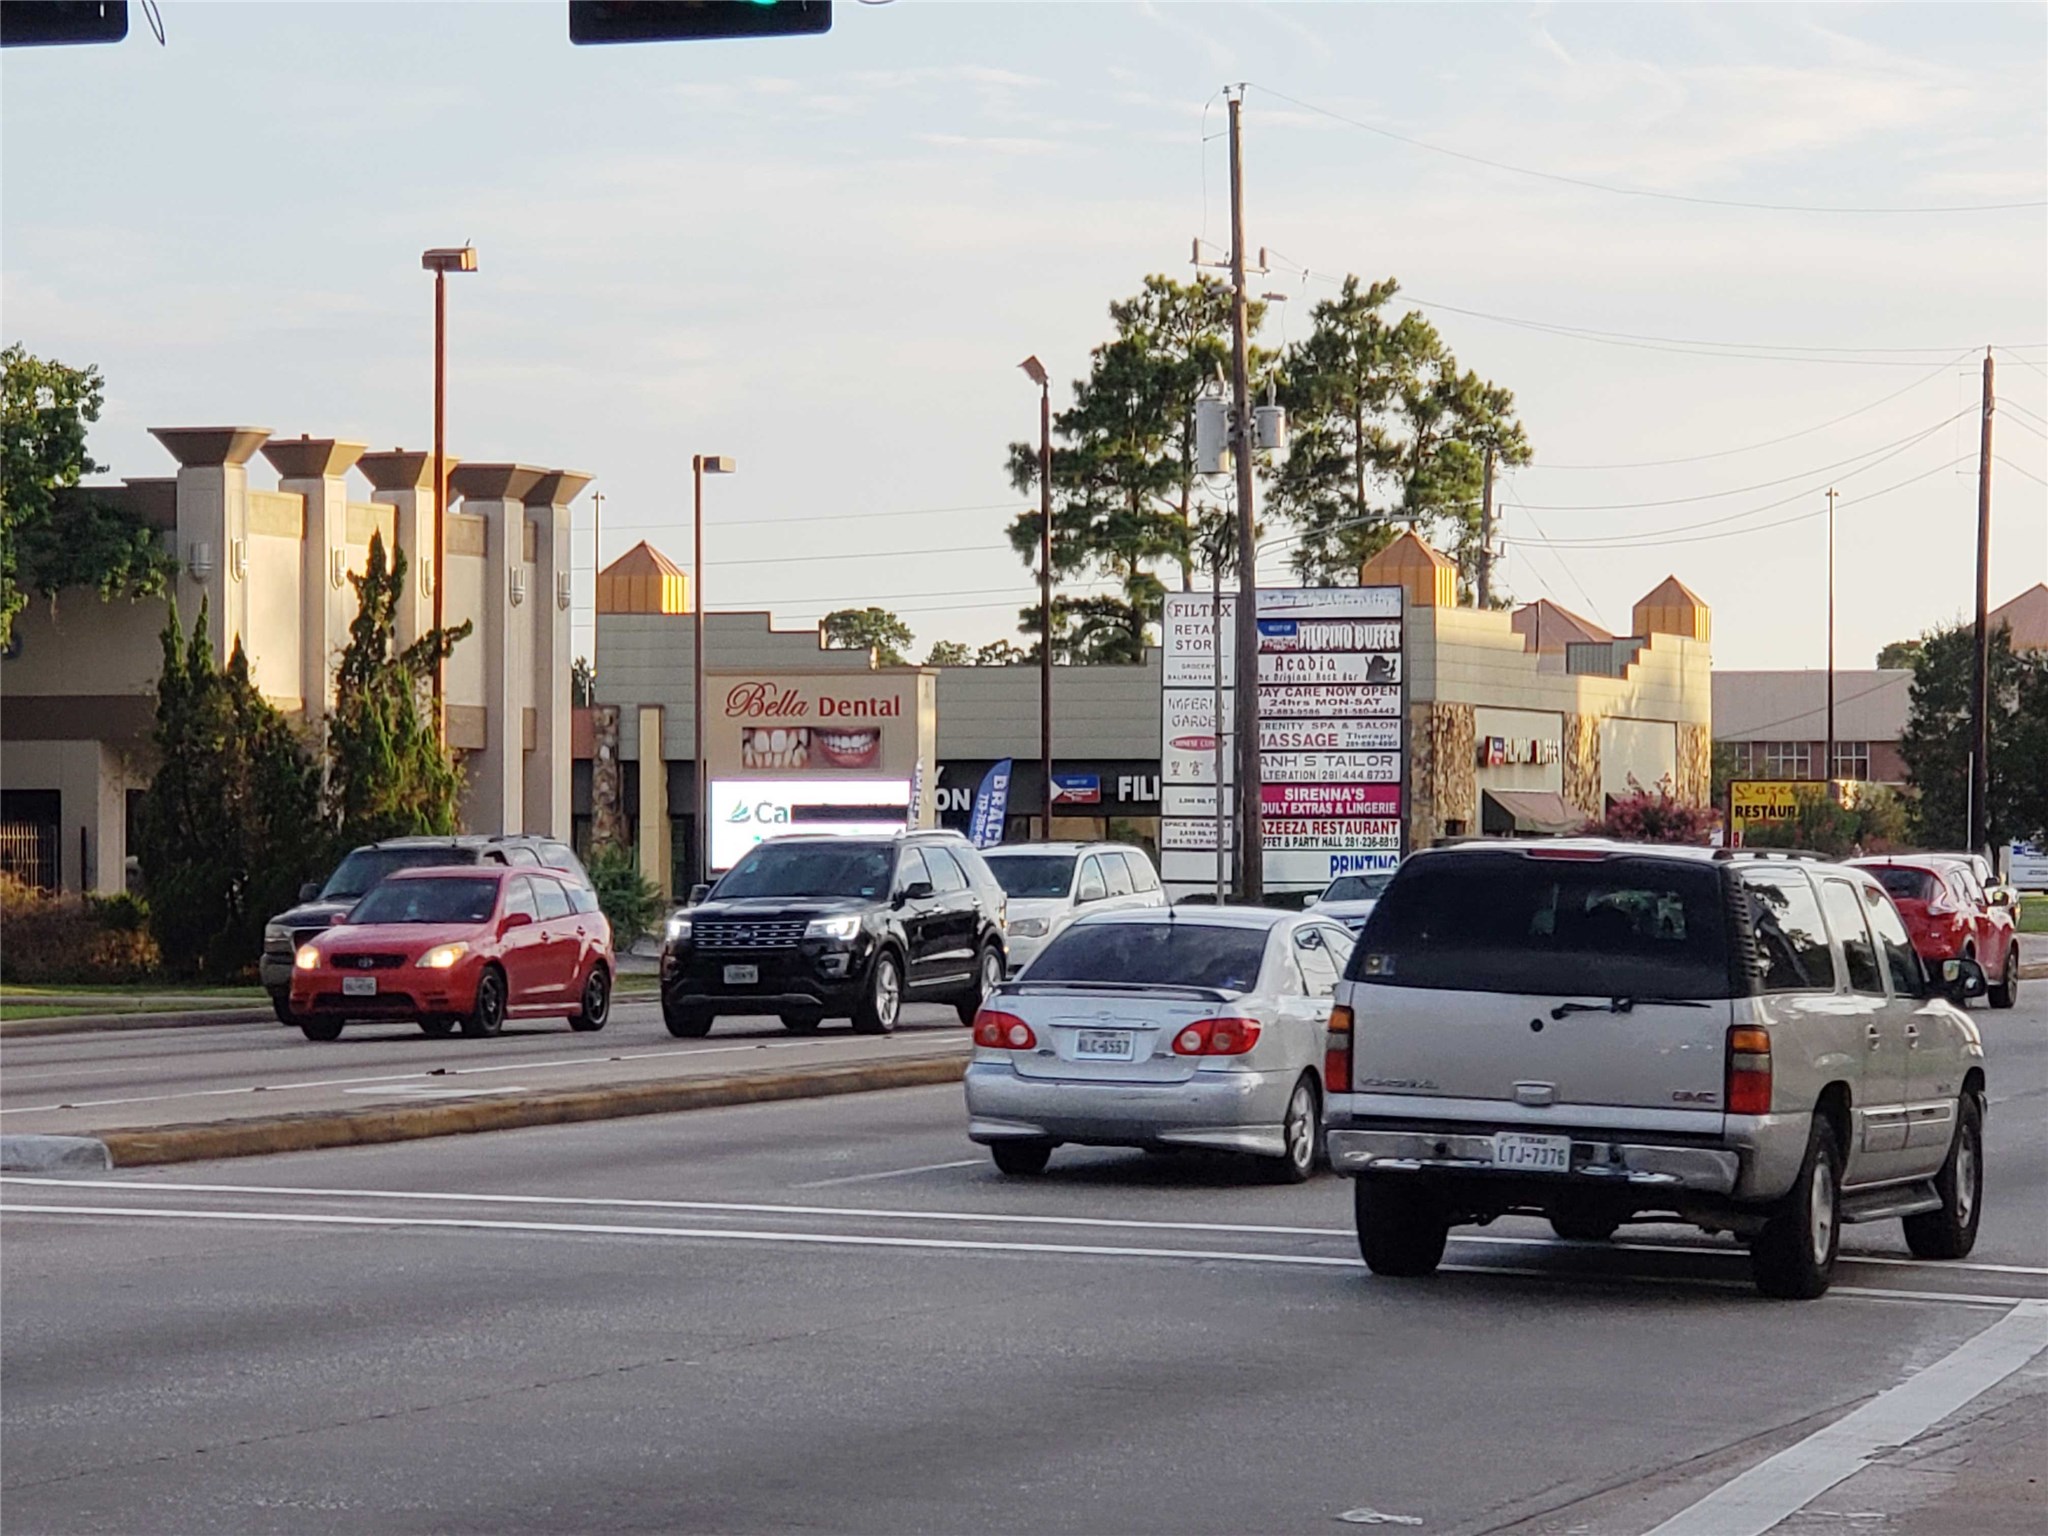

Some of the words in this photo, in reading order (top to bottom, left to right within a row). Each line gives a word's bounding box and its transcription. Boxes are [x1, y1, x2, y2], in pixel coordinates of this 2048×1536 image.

[1175, 624, 1222, 635] RETAI
[1300, 624, 1354, 650] FILIPINO
[1355, 624, 1400, 650] BUFFET
[1175, 639, 1212, 650] STOR
[1275, 655, 1336, 671] Acadia
[1274, 673, 1310, 684] Original
[1316, 673, 1336, 681] Rock
[1284, 687, 1321, 698] CARE
[1325, 687, 1357, 697] NOW
[1361, 686, 1398, 696] OPEN
[725, 681, 808, 718] Bella
[819, 695, 900, 717] Dental
[1269, 699, 1310, 707] 24hrs
[1315, 698, 1382, 706] MON-SAT
[1311, 722, 1336, 730] SPA
[1341, 722, 1349, 730] &
[1356, 722, 1398, 730] SALON
[1346, 733, 1394, 741] Therapy
[1323, 755, 1394, 767] TAILOR
[1262, 770, 1317, 780] LTERATION
[1118, 775, 1160, 801] FILI
[1284, 787, 1365, 801] SIRENNA'S
[1261, 802, 1288, 814] DULT
[1291, 802, 1333, 814] EXTRAS
[1335, 802, 1343, 814] &
[1347, 801, 1397, 814] LINGERIE
[1312, 820, 1398, 835] RESTAURANT
[1293, 837, 1320, 847] PARTY
[1322, 837, 1343, 847] HALL
[1499, 1145, 1565, 1166] LTJ-7376
